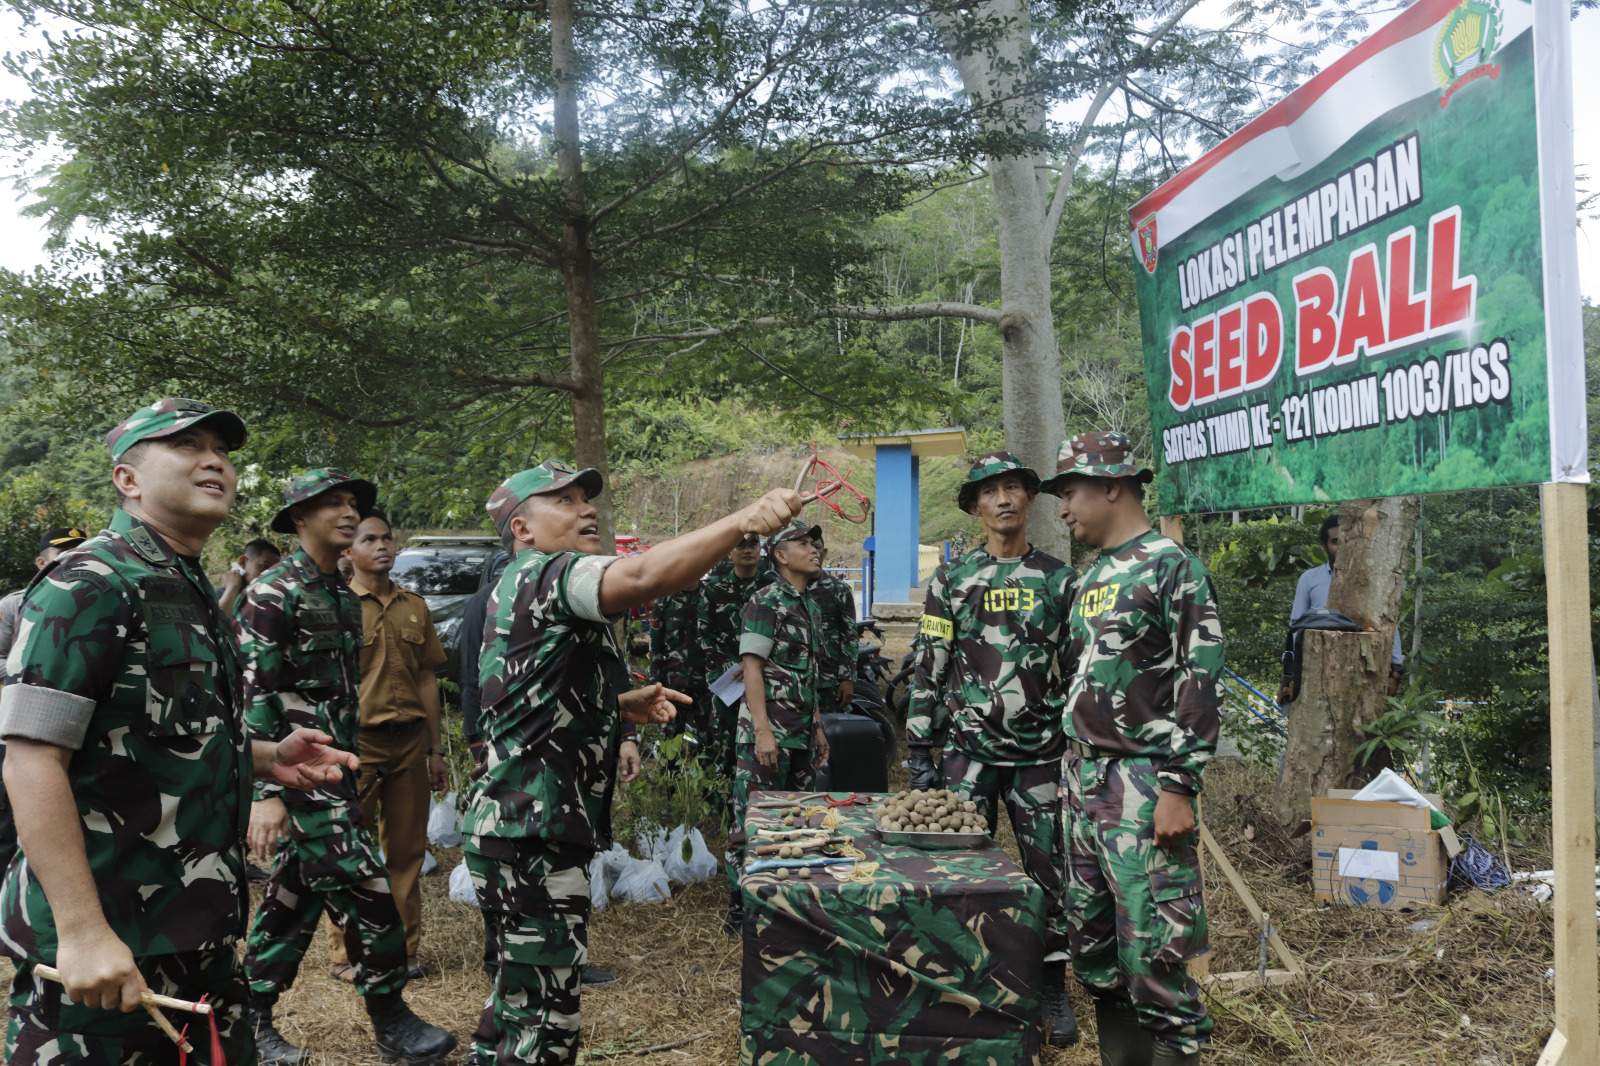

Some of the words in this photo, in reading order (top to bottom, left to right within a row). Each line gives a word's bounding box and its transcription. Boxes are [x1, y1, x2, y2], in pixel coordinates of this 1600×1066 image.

[1178, 232, 1246, 309] LOKASI
[1247, 136, 1421, 276] PELEMPARAN
[1169, 291, 1284, 412] SEED
[1292, 205, 1477, 376] BALL
[1163, 420, 1208, 464] SATGAS
[1207, 410, 1251, 455] TMMD
[1312, 376, 1380, 435] KODIM
[1381, 342, 1510, 421] 1003/HSS
[984, 587, 1034, 612] 1003
[1080, 583, 1120, 618] 1003
